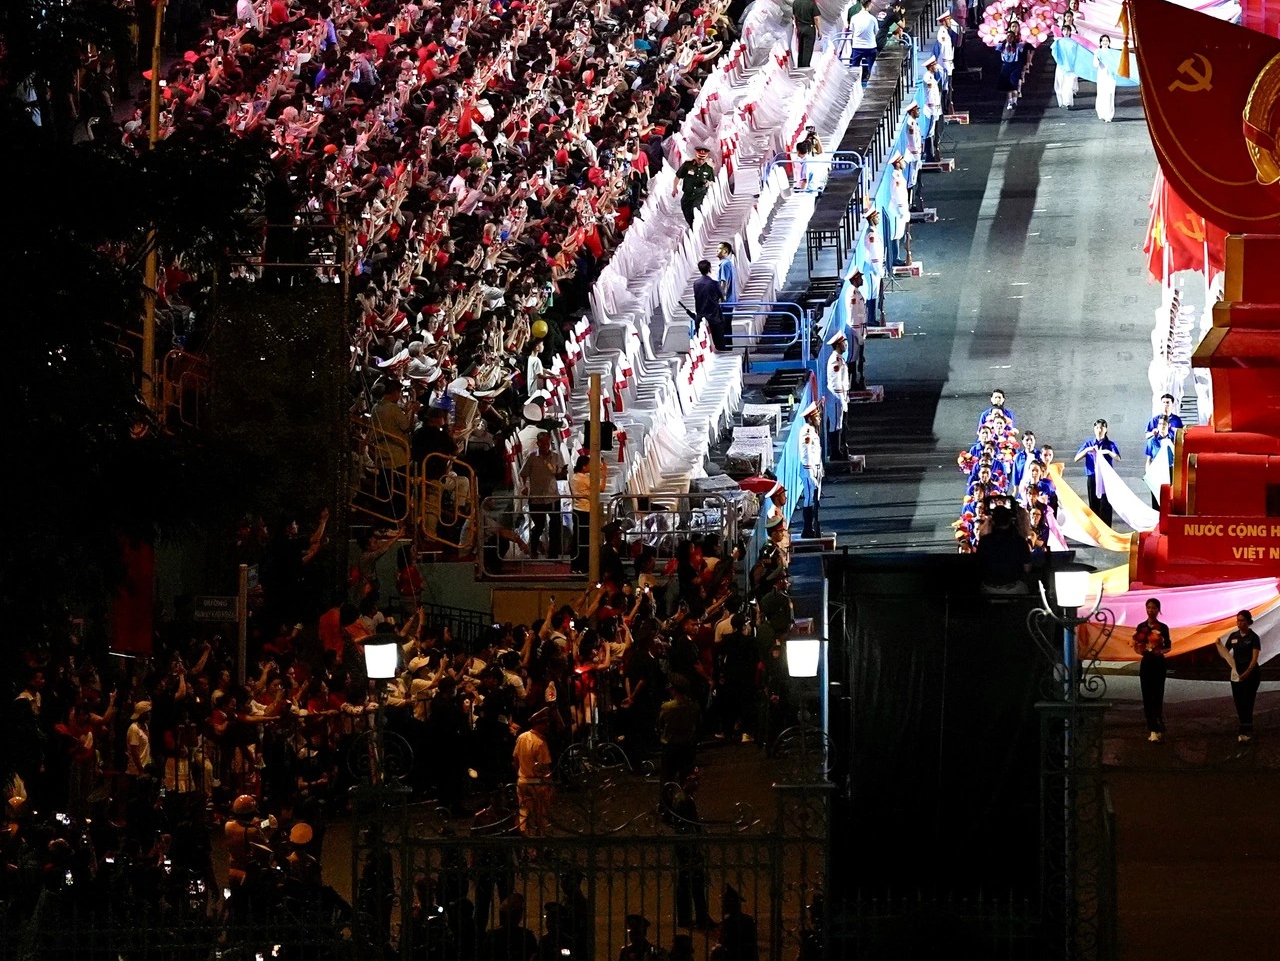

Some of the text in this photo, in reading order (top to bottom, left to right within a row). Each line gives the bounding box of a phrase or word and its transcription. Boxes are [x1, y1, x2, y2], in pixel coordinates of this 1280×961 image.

[1184, 521, 1224, 537] NƯỚC
[1228, 522, 1267, 539] CỘNG
[1232, 545, 1265, 561] VIỆT
